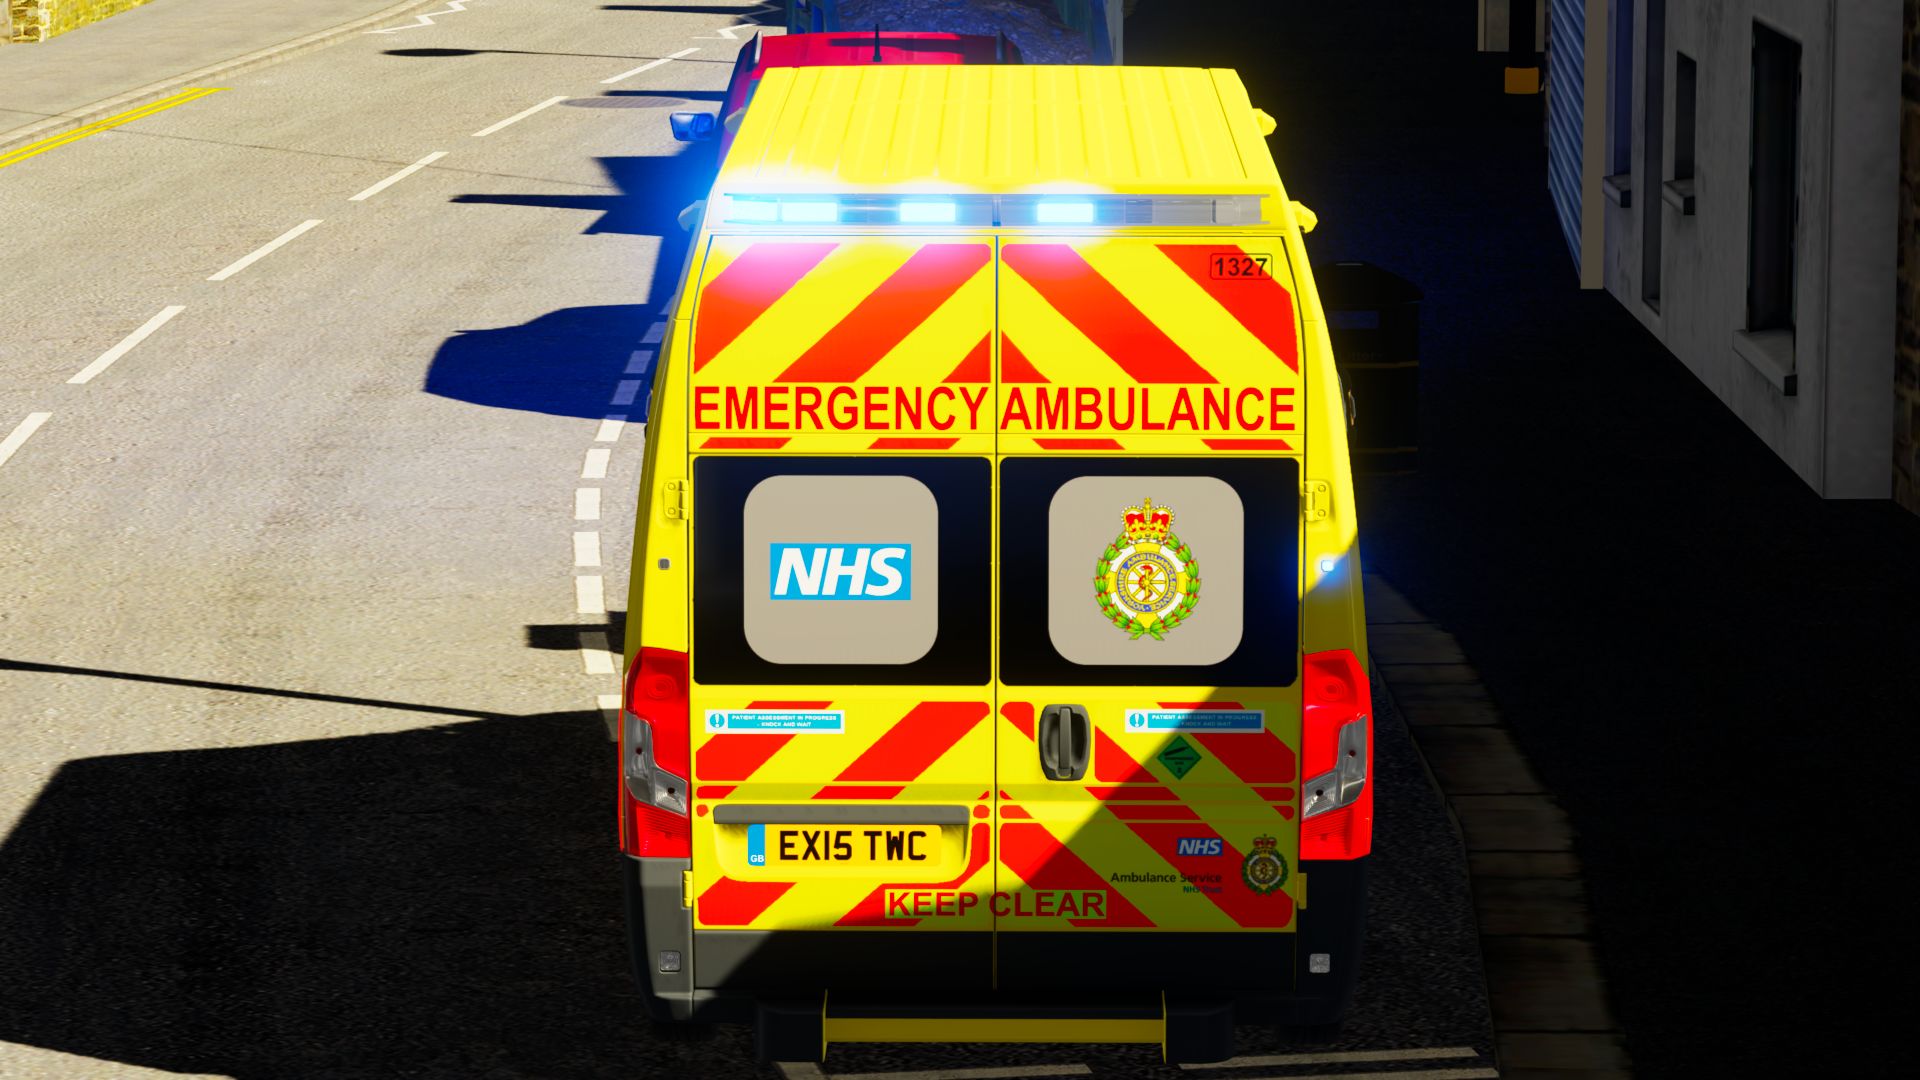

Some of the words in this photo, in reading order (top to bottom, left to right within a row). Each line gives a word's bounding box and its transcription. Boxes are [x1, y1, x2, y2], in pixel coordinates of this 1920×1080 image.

[1215, 257, 1268, 276] 1327
[694, 386, 989, 431] EMERGENCY
[1001, 386, 1296, 431] AMBULANCE
[774, 547, 905, 596] NHS
[779, 830, 852, 860] EX15
[864, 830, 927, 860] TWC
[1178, 839, 1221, 855] NHS
[750, 855, 765, 863] GB
[1110, 872, 1177, 884] Ambulance
[1180, 872, 1222, 884] Service
[888, 892, 979, 917] KEEP
[989, 892, 1105, 917] CLEAR
